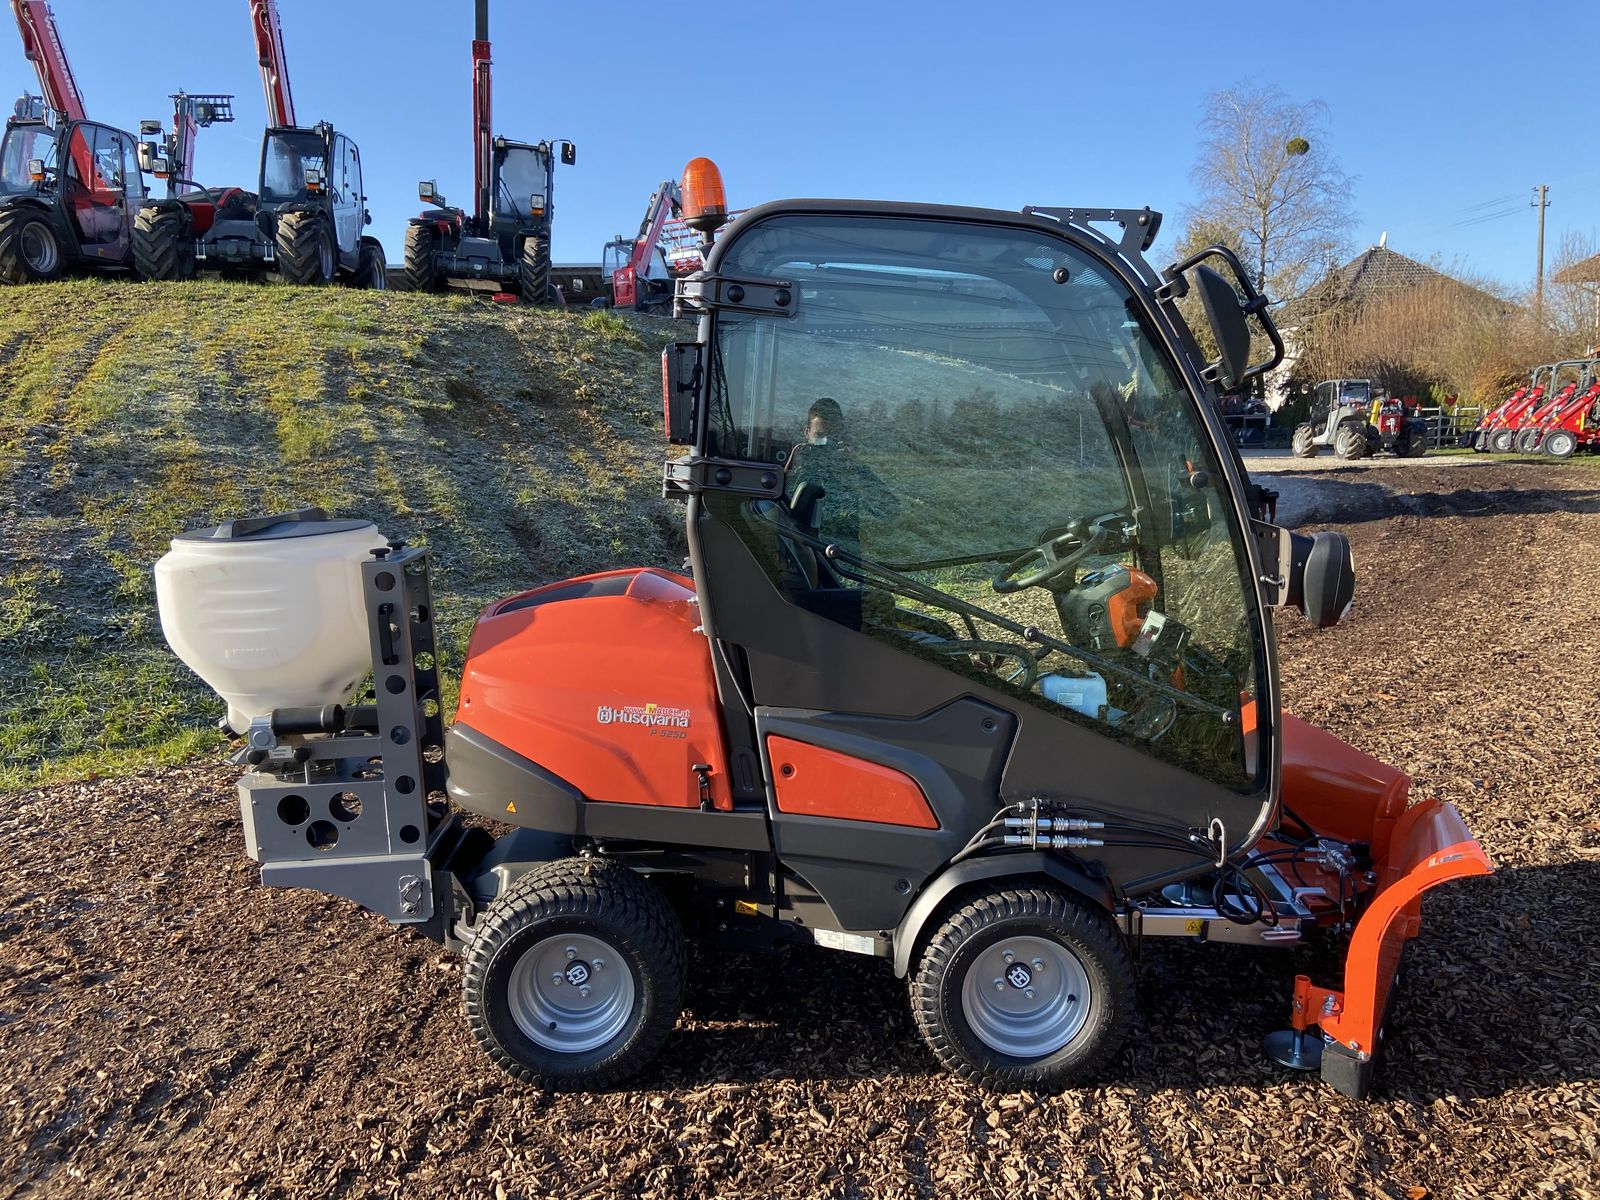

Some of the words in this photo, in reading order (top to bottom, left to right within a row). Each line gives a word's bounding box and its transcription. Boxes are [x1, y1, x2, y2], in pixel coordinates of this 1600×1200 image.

[44, 15, 77, 98] WEIDEMANN
[613, 709, 689, 727] Husqvarna
[660, 730, 687, 739] 525D
